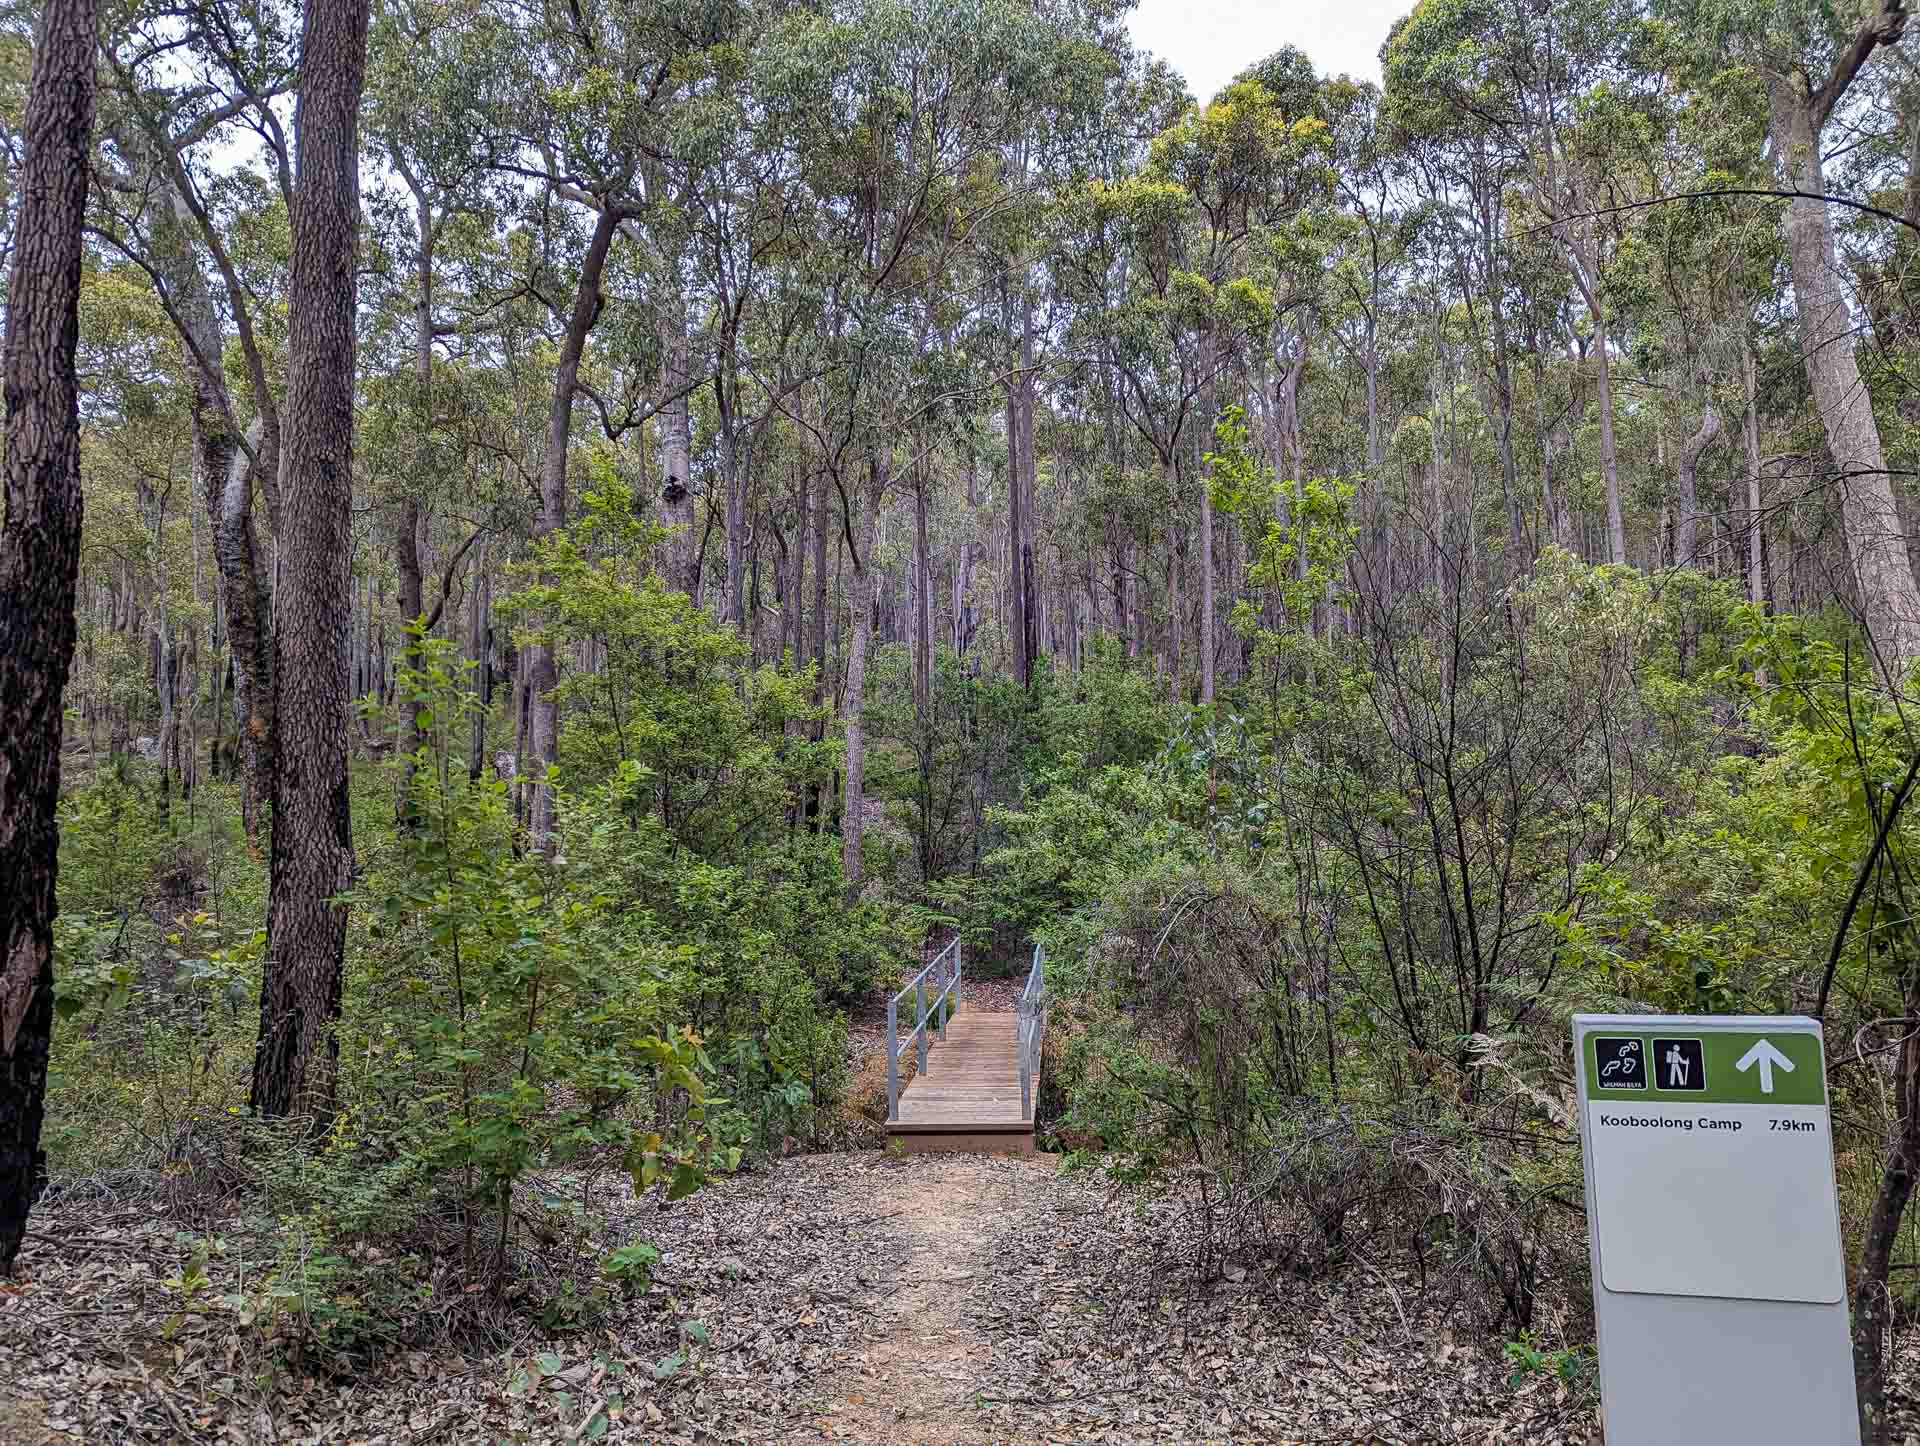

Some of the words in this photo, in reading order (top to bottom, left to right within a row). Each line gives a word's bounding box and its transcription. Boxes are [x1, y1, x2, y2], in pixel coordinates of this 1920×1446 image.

[1600, 1115, 1693, 1130] Kooboolong
[1698, 1117, 1742, 1131] Camp
[1768, 1119, 1816, 1131] 7.9km
